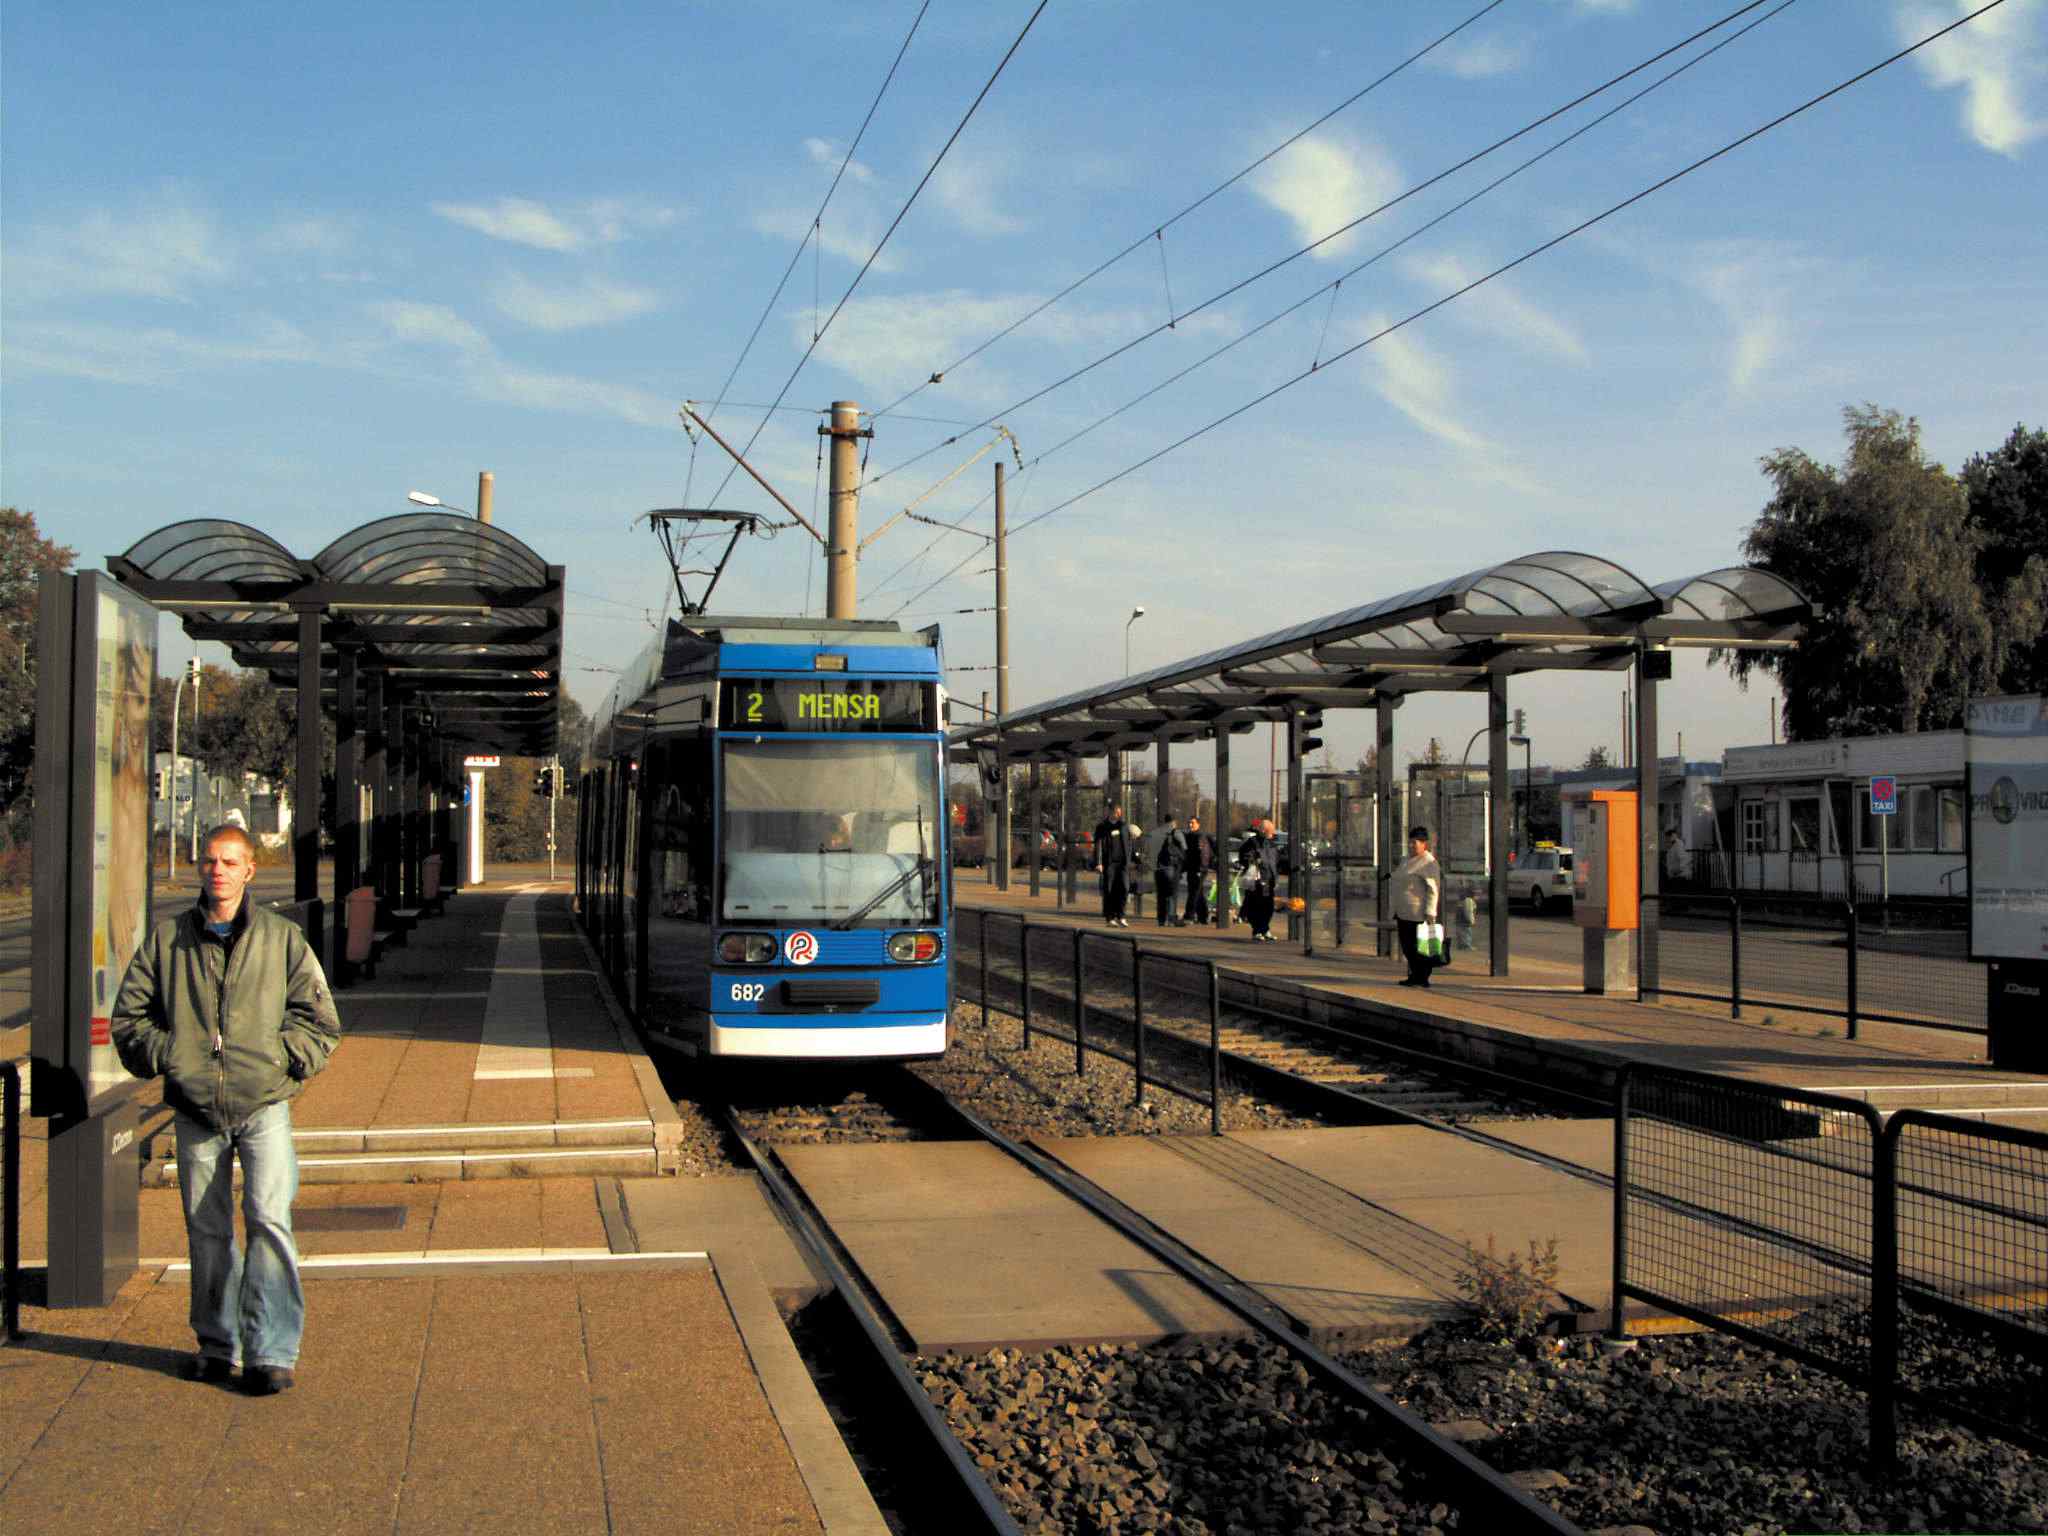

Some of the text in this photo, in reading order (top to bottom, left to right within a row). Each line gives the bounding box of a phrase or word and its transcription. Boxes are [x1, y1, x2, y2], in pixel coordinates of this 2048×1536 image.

[748, 692, 880, 719] 2 MENSA
[731, 983, 765, 1001] 682
